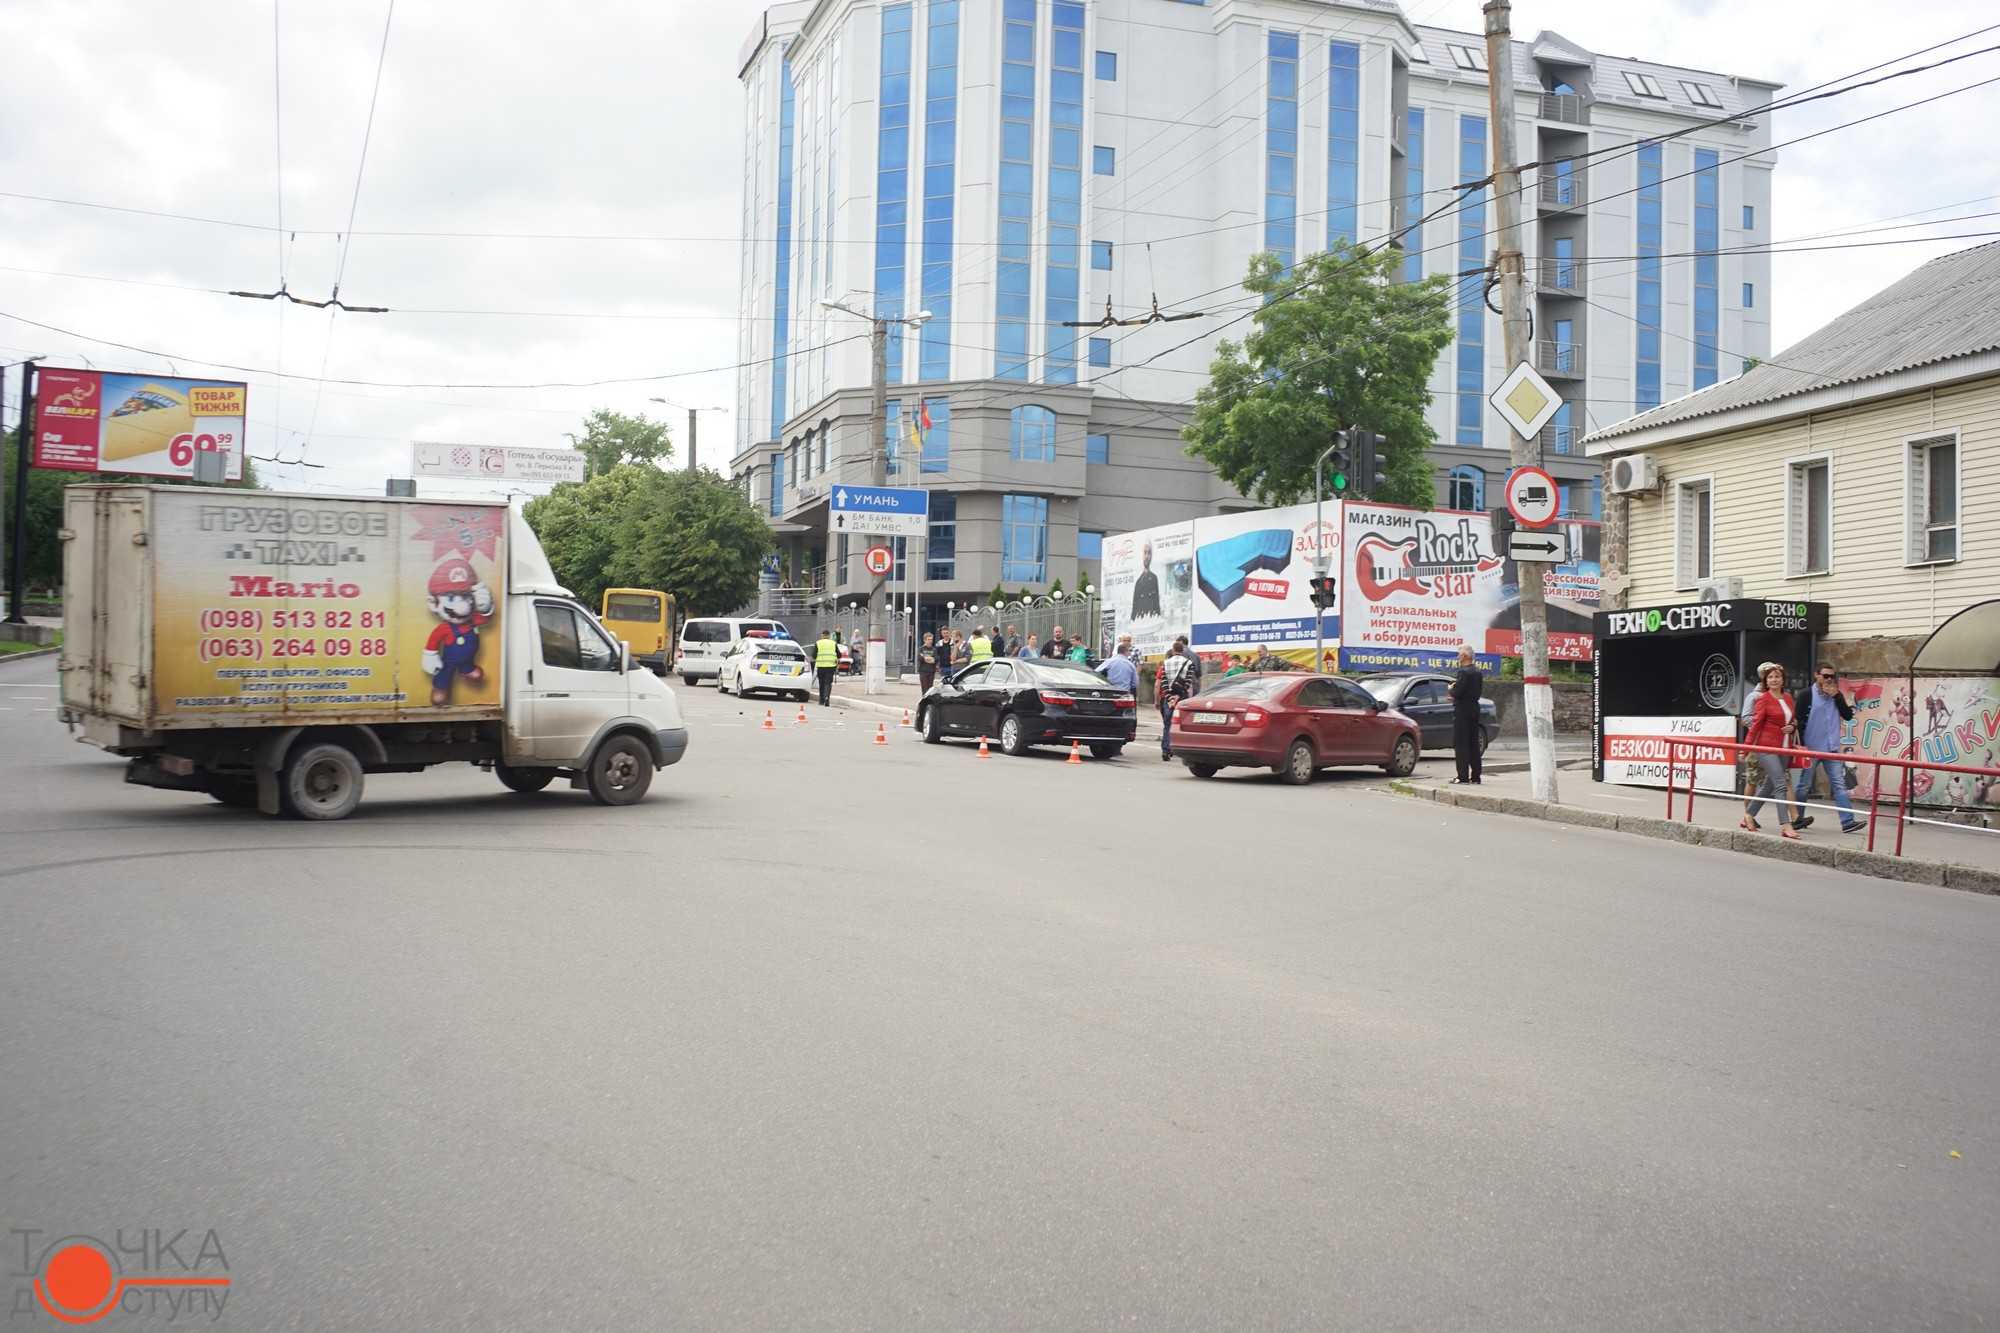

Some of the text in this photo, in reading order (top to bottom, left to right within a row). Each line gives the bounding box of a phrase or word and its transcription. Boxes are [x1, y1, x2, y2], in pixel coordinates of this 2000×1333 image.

[194, 391, 235, 401] ТОВАР
[193, 402, 240, 412] ТИЖНЯ
[853, 494, 900, 507] УМАНЬ
[201, 506, 388, 537] ГРУЗОВОЕ
[869, 514, 893, 523] БАНК
[1348, 511, 1412, 528] МАГАЗИН
[875, 523, 902, 532] УМВС
[1416, 518, 1480, 563] Rock
[229, 575, 361, 598] Mario
[1434, 569, 1476, 598] star
[1370, 604, 1457, 619] музыкальных
[1764, 602, 1808, 617] ТЕХНО
[201, 609, 386, 631] (098) 513 82 81
[1370, 618, 1457, 633] инструментов
[1608, 603, 1732, 635] ТЕХНО-СЕРВІС
[1764, 616, 1808, 630] СЕРВІС
[1363, 631, 1464, 648] и оборудования
[1564, 637, 1578, 648] ул.
[200, 638, 387, 661] (063) 264 09 88
[1350, 654, 1419, 668] КІРОВОГРАД
[1428, 659, 1442, 668] ЦЕ
[1711, 674, 1723, 687] 12
[1671, 720, 1702, 733] У НАС
[1626, 763, 1698, 779] ДІАГНОСИК
